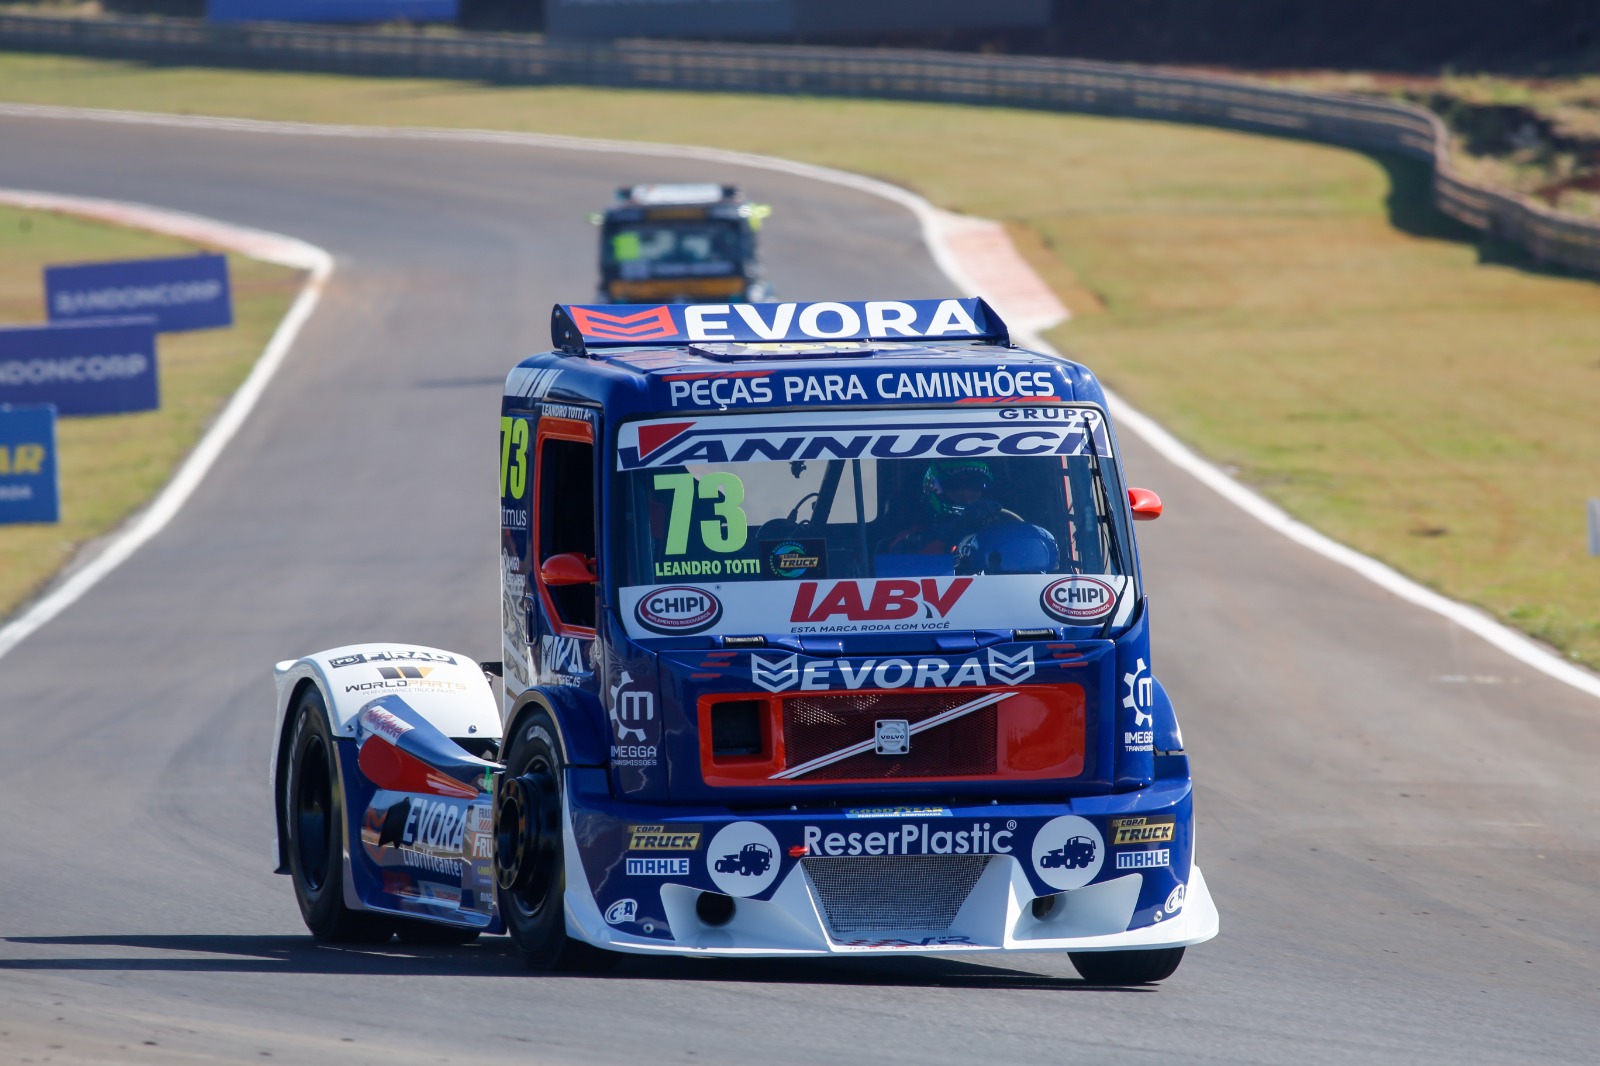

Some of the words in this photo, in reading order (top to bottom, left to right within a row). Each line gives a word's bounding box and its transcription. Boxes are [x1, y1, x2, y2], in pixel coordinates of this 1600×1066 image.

[684, 300, 979, 341] EVORA
[670, 378, 773, 411] PEÇAS
[784, 374, 868, 402] PARA
[876, 365, 1055, 399] CAMINHÕES
[542, 404, 567, 418] LEANDRO
[568, 407, 584, 420] TOTTI
[999, 408, 1098, 421] GRUPO
[500, 415, 529, 500] 73
[653, 471, 748, 555] 73
[655, 560, 722, 577] LEANDRO
[724, 558, 761, 575] TOTTI
[782, 559, 816, 567] TRUCK
[1054, 588, 1104, 603] CHIPI
[650, 597, 705, 614] CHIPI
[819, 625, 858, 633] MARCA
[860, 624, 891, 632] RODA
[921, 621, 950, 630] VOCÊ
[362, 651, 451, 663] FIRAD
[801, 656, 988, 690] EVORA
[362, 688, 413, 696] PERFORMANCE
[402, 798, 468, 854] EVORA
[635, 825, 663, 833] COPA
[1119, 826, 1172, 841] TRUCK
[634, 835, 696, 849] TRUCK
[402, 845, 464, 877] Lubrificantes
[627, 859, 689, 874] MAHLE
[1118, 850, 1169, 868] MAHLE
